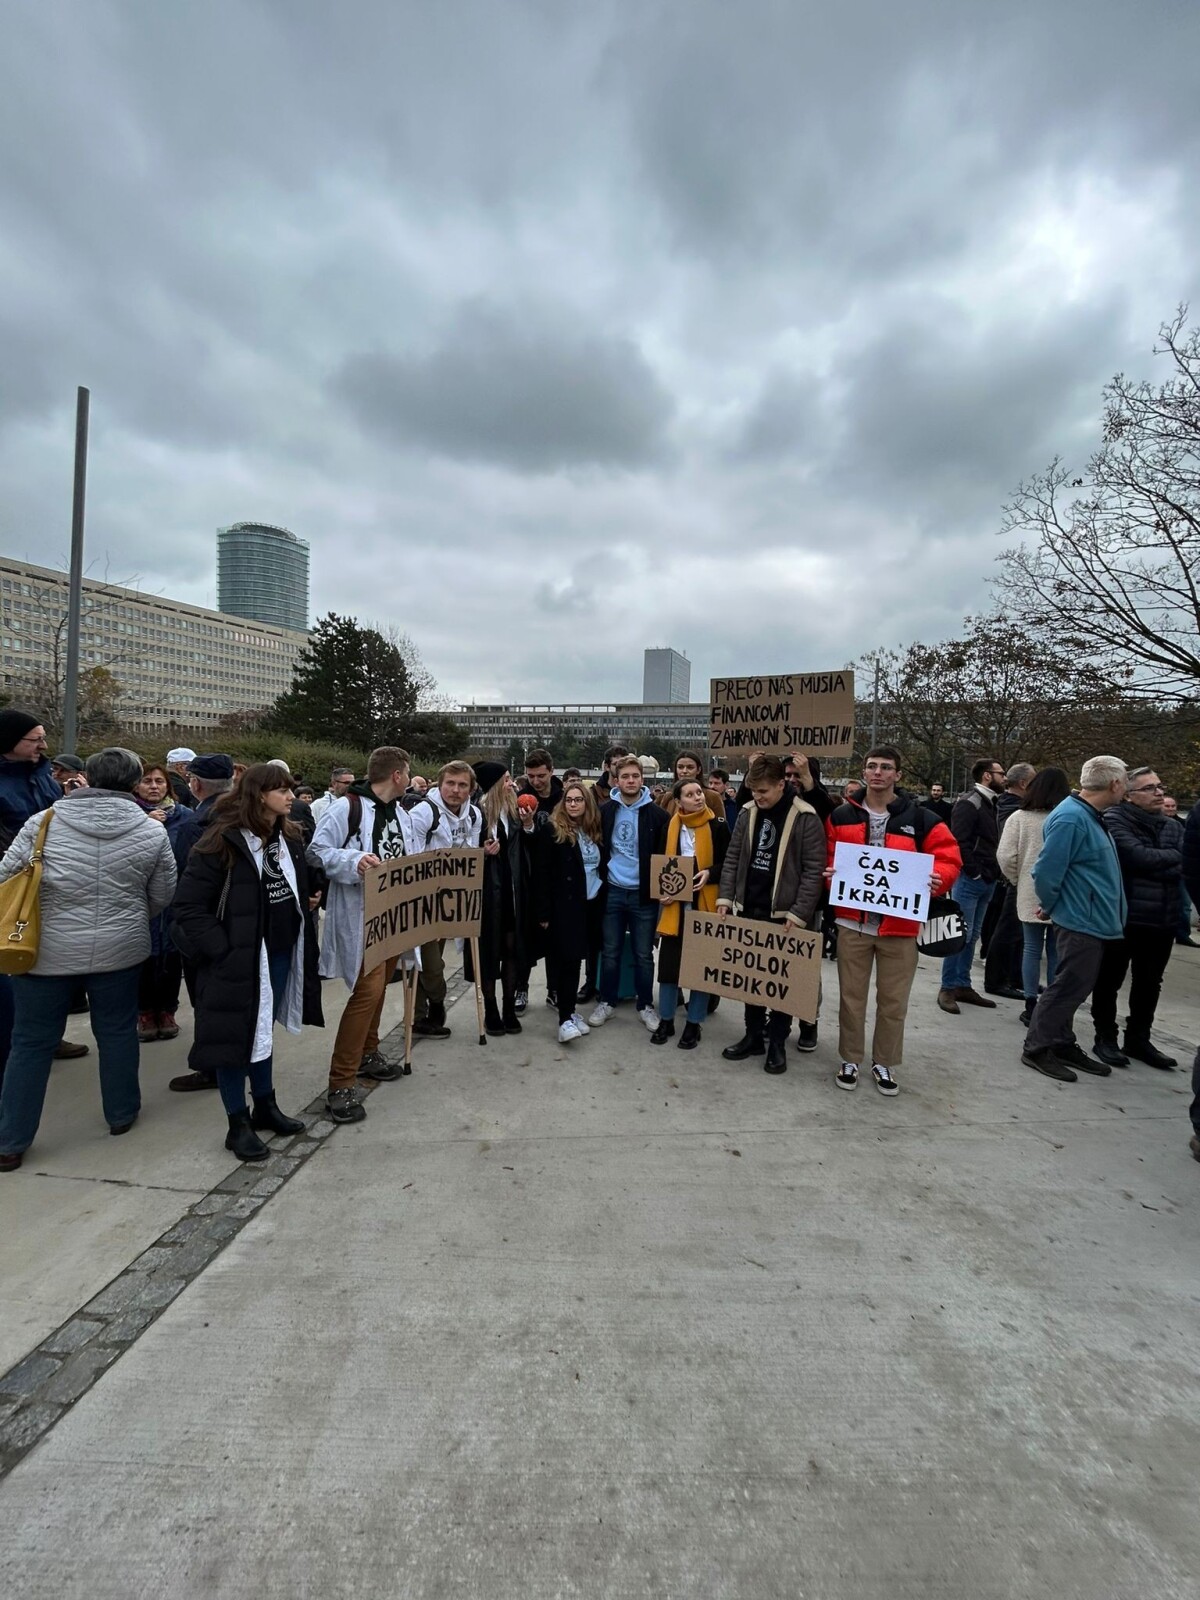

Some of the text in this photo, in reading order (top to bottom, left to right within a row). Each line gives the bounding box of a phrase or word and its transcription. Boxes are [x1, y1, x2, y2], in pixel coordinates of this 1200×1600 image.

[715, 674, 845, 703] PREČO NÁS MUSIA
[711, 725, 779, 749] ZAHRANIČNÍ
[378, 852, 477, 893] ZACHRÁŇME
[858, 851, 899, 874] ČAS
[863, 873, 890, 889] SA
[693, 920, 816, 960] BRATISLAVSKÝ
[917, 914, 962, 946] NIKE
[722, 947, 790, 979] SPOLOK
[704, 966, 789, 1000] MEDIKOV
